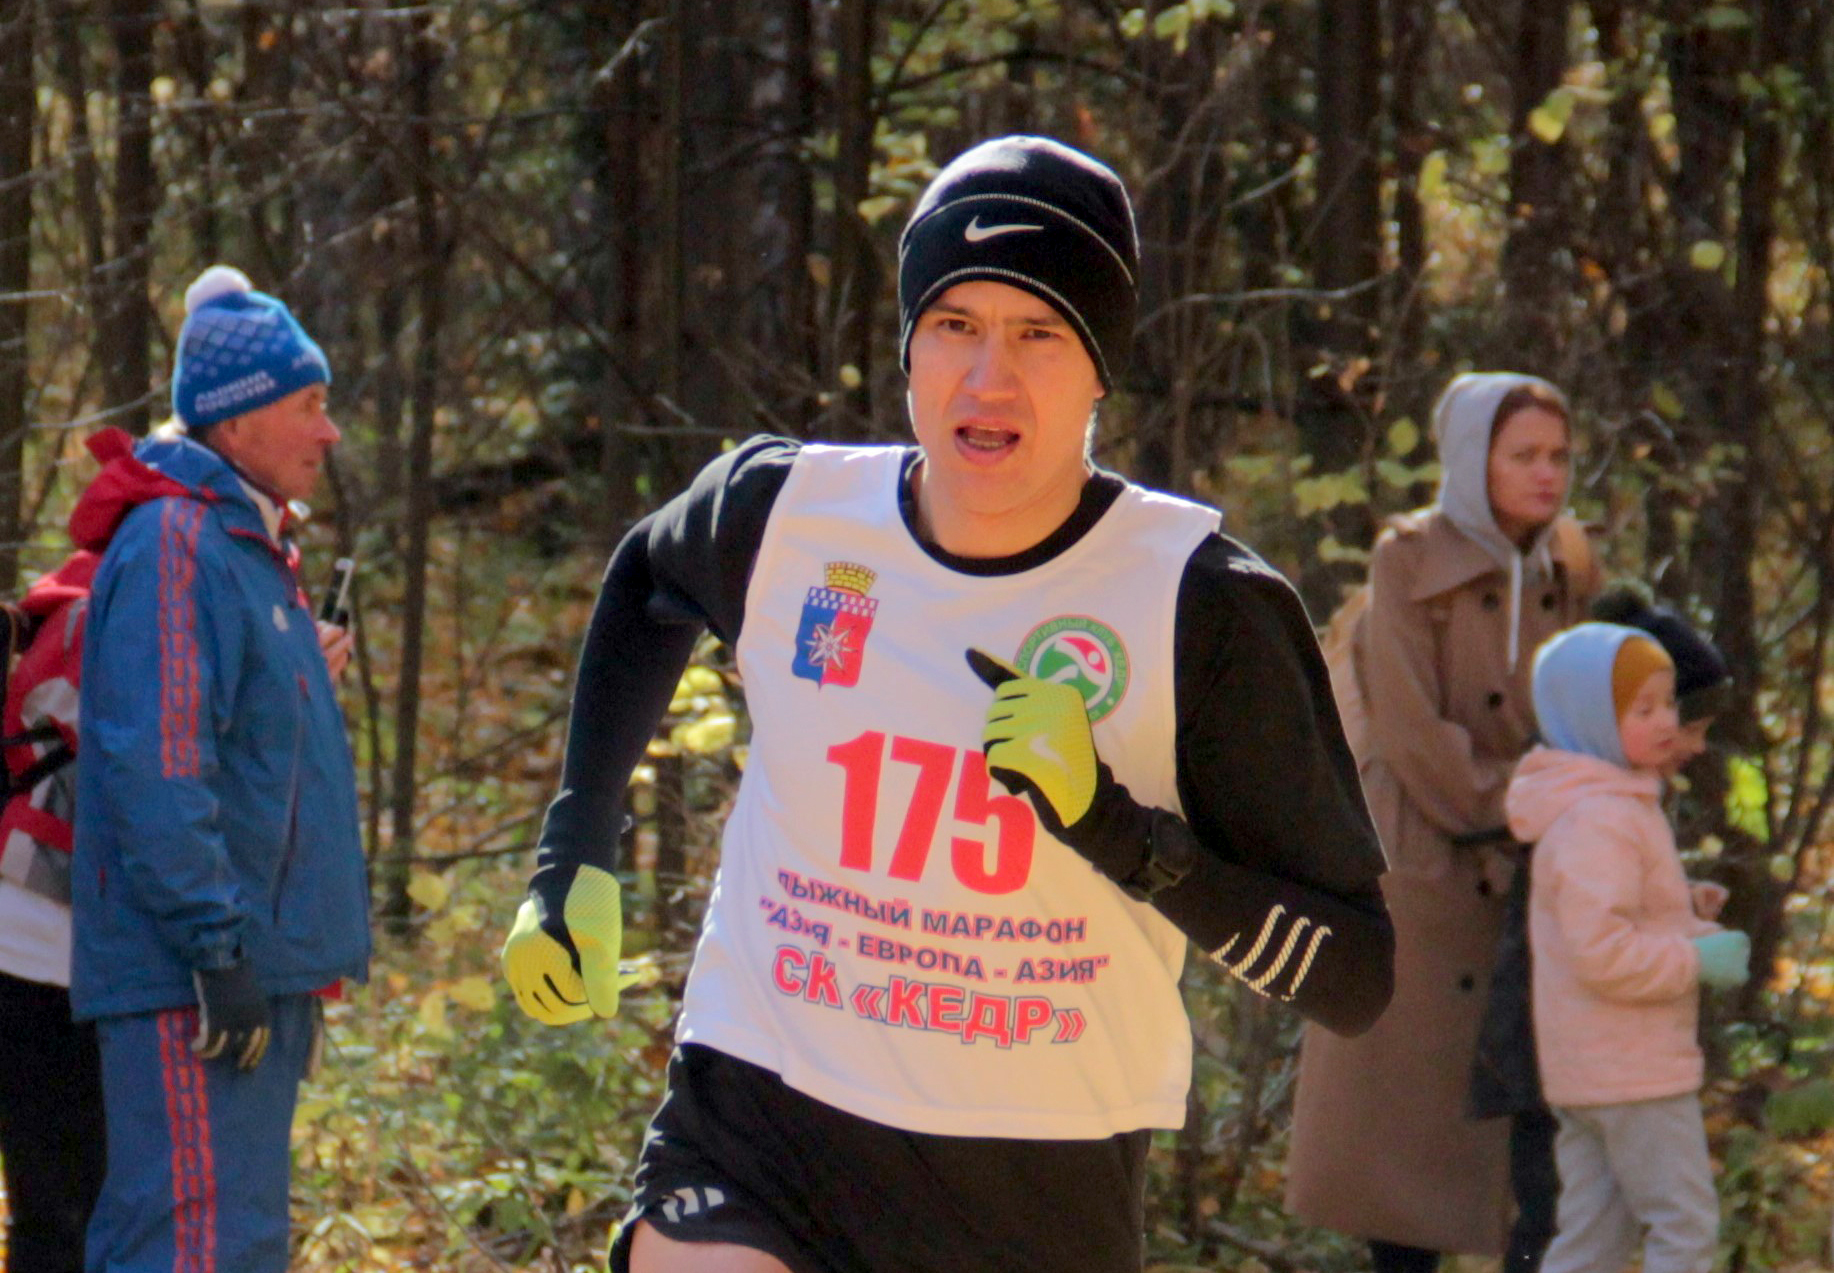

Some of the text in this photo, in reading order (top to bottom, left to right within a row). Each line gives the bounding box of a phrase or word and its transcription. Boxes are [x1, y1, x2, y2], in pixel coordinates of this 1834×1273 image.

[827, 730, 1036, 895] 175
[857, 931, 987, 983] ЕВРОПА
[921, 909, 1088, 945] МАРАФОН
[772, 944, 1087, 1050] СК «КЕДР»
